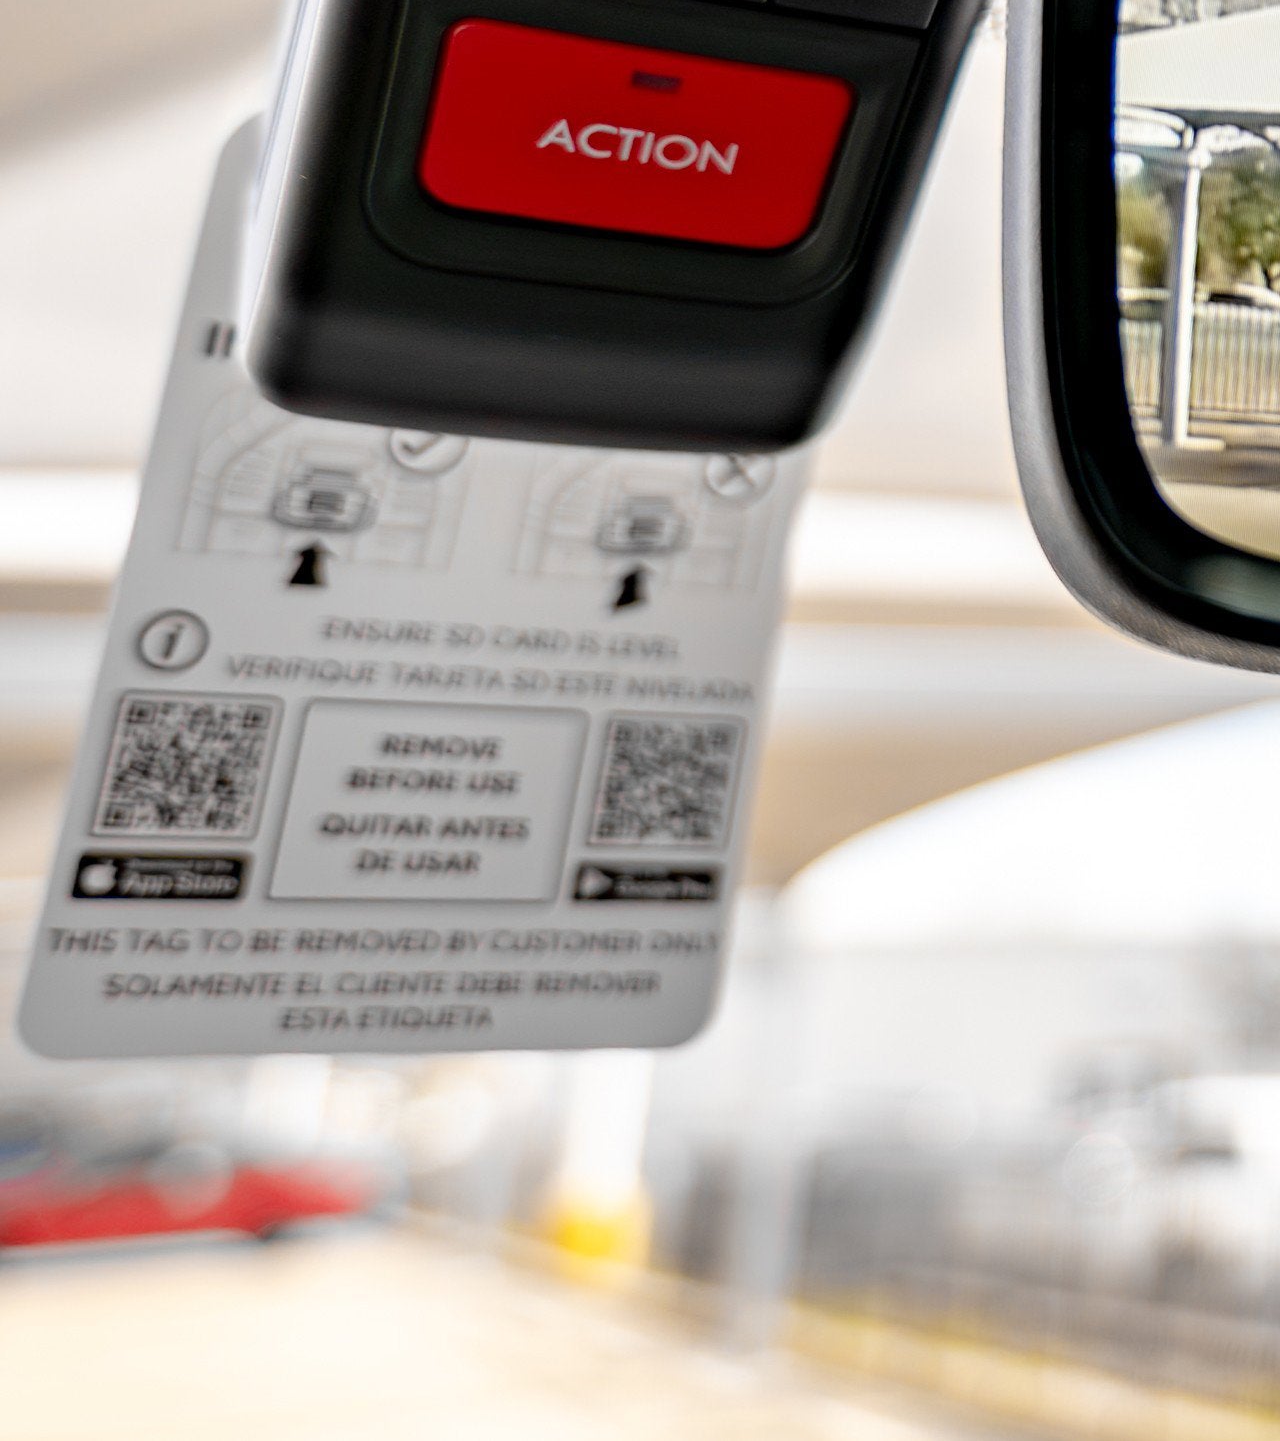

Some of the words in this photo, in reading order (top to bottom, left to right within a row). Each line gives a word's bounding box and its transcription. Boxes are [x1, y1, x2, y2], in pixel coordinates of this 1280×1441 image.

[536, 118, 739, 175] ACTION
[321, 616, 434, 644] ENSURE
[446, 621, 486, 649] SD
[489, 624, 572, 652] CARD
[602, 631, 680, 661] LEVEL
[226, 655, 379, 685] VERIFIQUE
[391, 662, 502, 690] TARJETA
[377, 732, 502, 760] REMOVE
[343, 766, 456, 794] BEFORE
[465, 770, 522, 795] USE
[317, 813, 431, 840] QUITAR
[438, 816, 531, 841] ANTES
[353, 848, 396, 874] DE
[402, 850, 482, 875] USAR
[49, 926, 118, 953] THIS
[127, 927, 191, 954] TAG
[198, 927, 243, 954] TO
[250, 928, 290, 954] BE
[294, 928, 442, 954] REMOVED
[445, 928, 486, 954] BY
[489, 928, 643, 954] CUSTOMER
[103, 972, 283, 999] SOLAMENTE
[335, 971, 448, 996] CLIENTE
[455, 970, 523, 996] DEBE
[531, 969, 662, 996] REMOVER
[277, 1006, 352, 1032] ESTA
[355, 1005, 496, 1031] ETIQUETA
